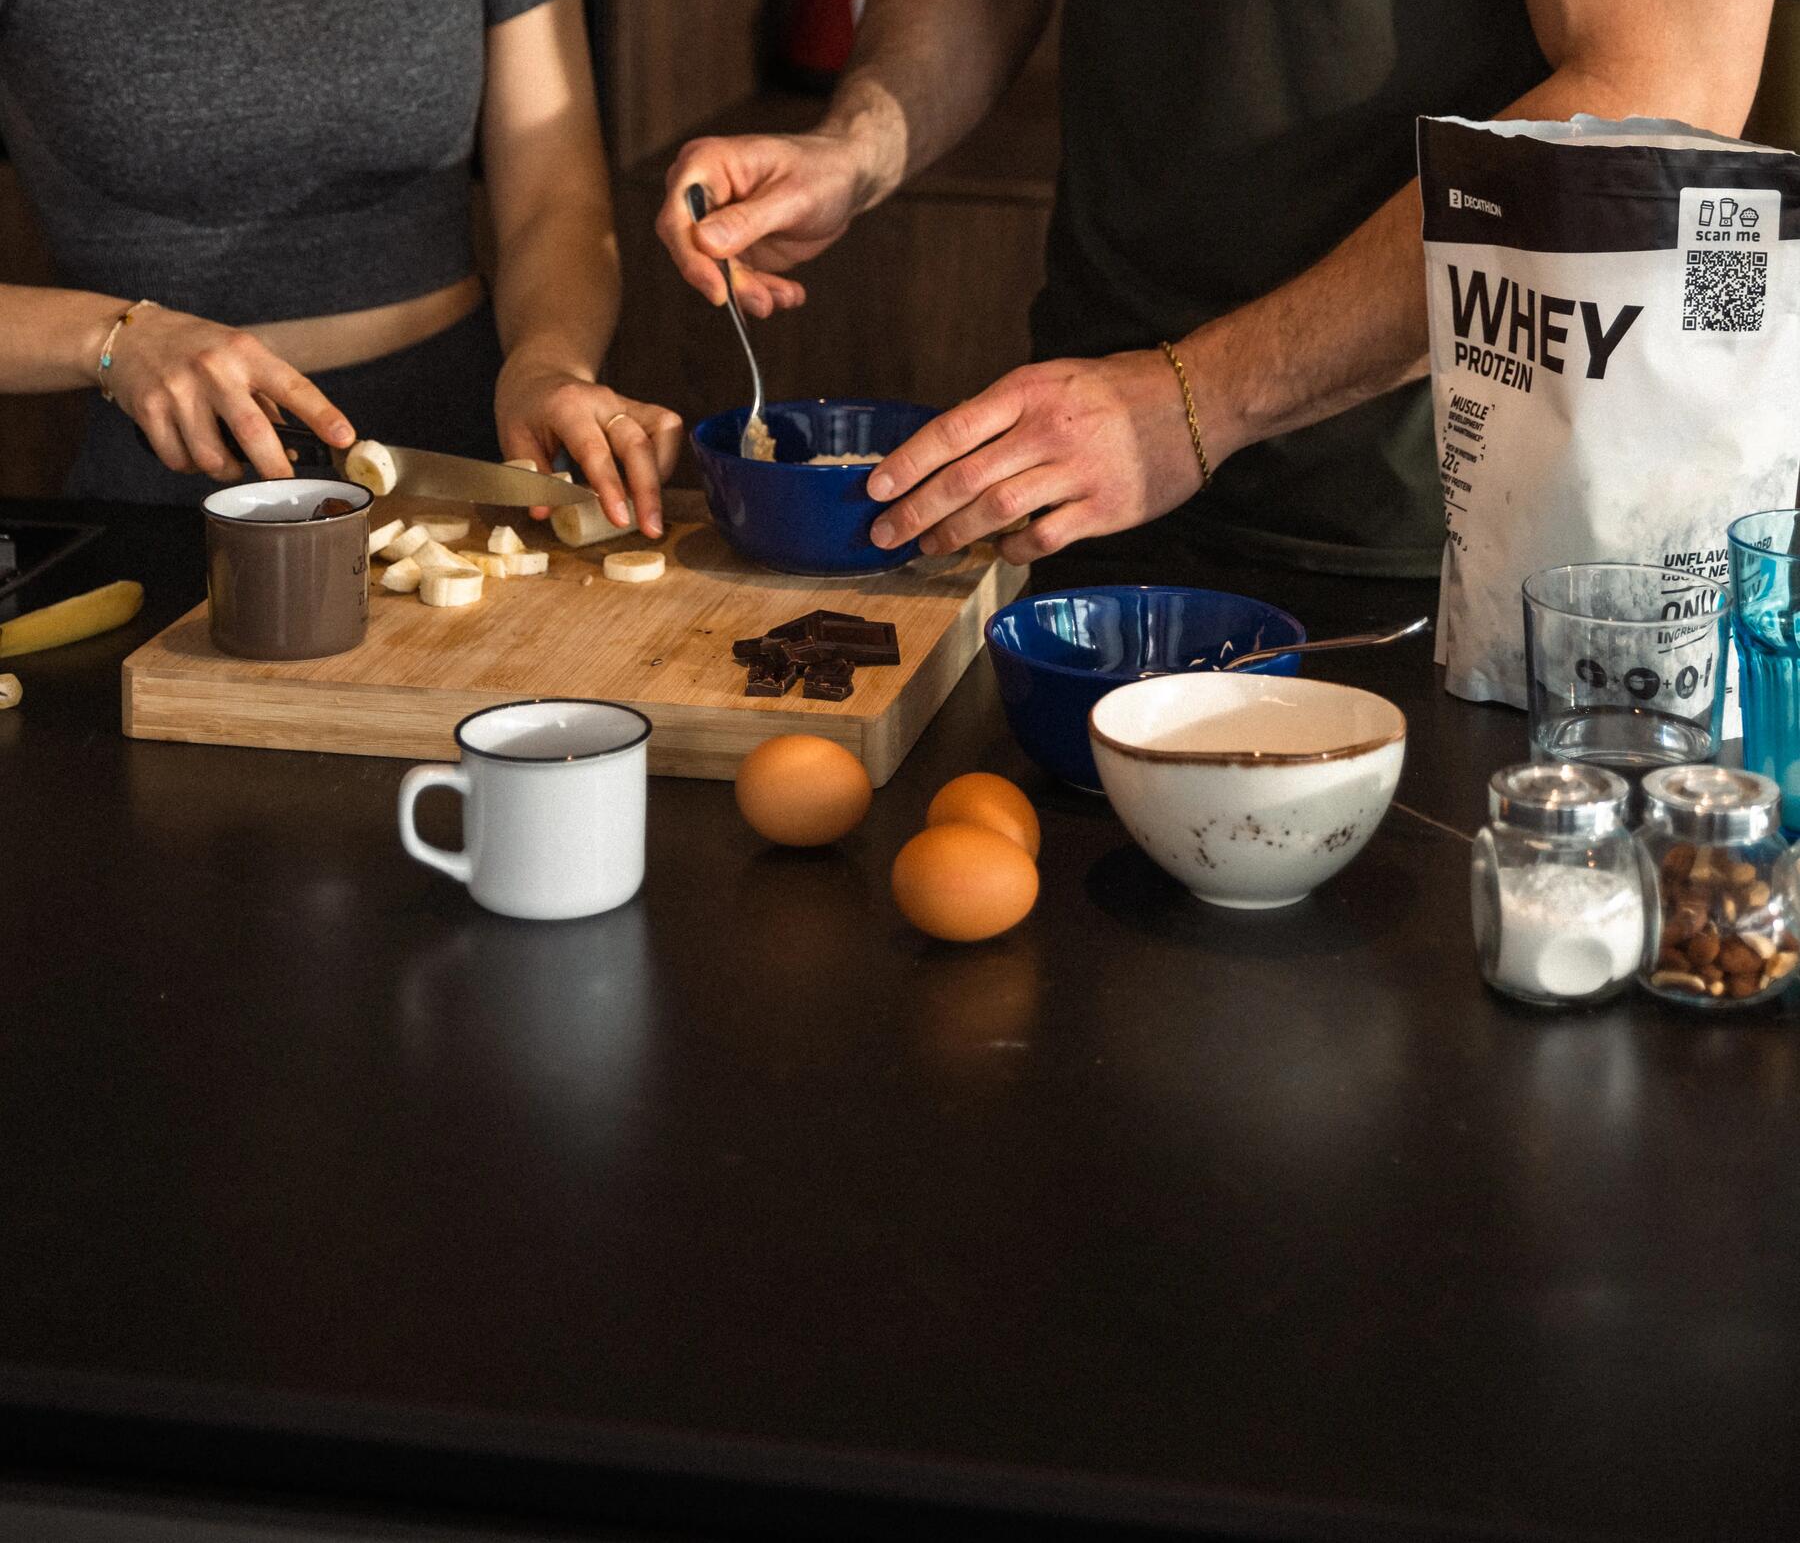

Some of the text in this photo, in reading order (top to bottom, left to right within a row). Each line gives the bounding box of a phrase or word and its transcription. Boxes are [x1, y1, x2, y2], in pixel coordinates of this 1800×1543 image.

[1695, 229, 1761, 242] scan me
[1447, 263, 1645, 380] WHEY
[1454, 341, 1534, 393] PROTEIN
[1450, 394, 1490, 420] MUSCLE
[1448, 411, 1485, 432] DEVELOPMENT
[1442, 451, 1456, 471] 22
[1451, 476, 1473, 493] PROTEIN
[1661, 589, 1718, 621] ONLY
